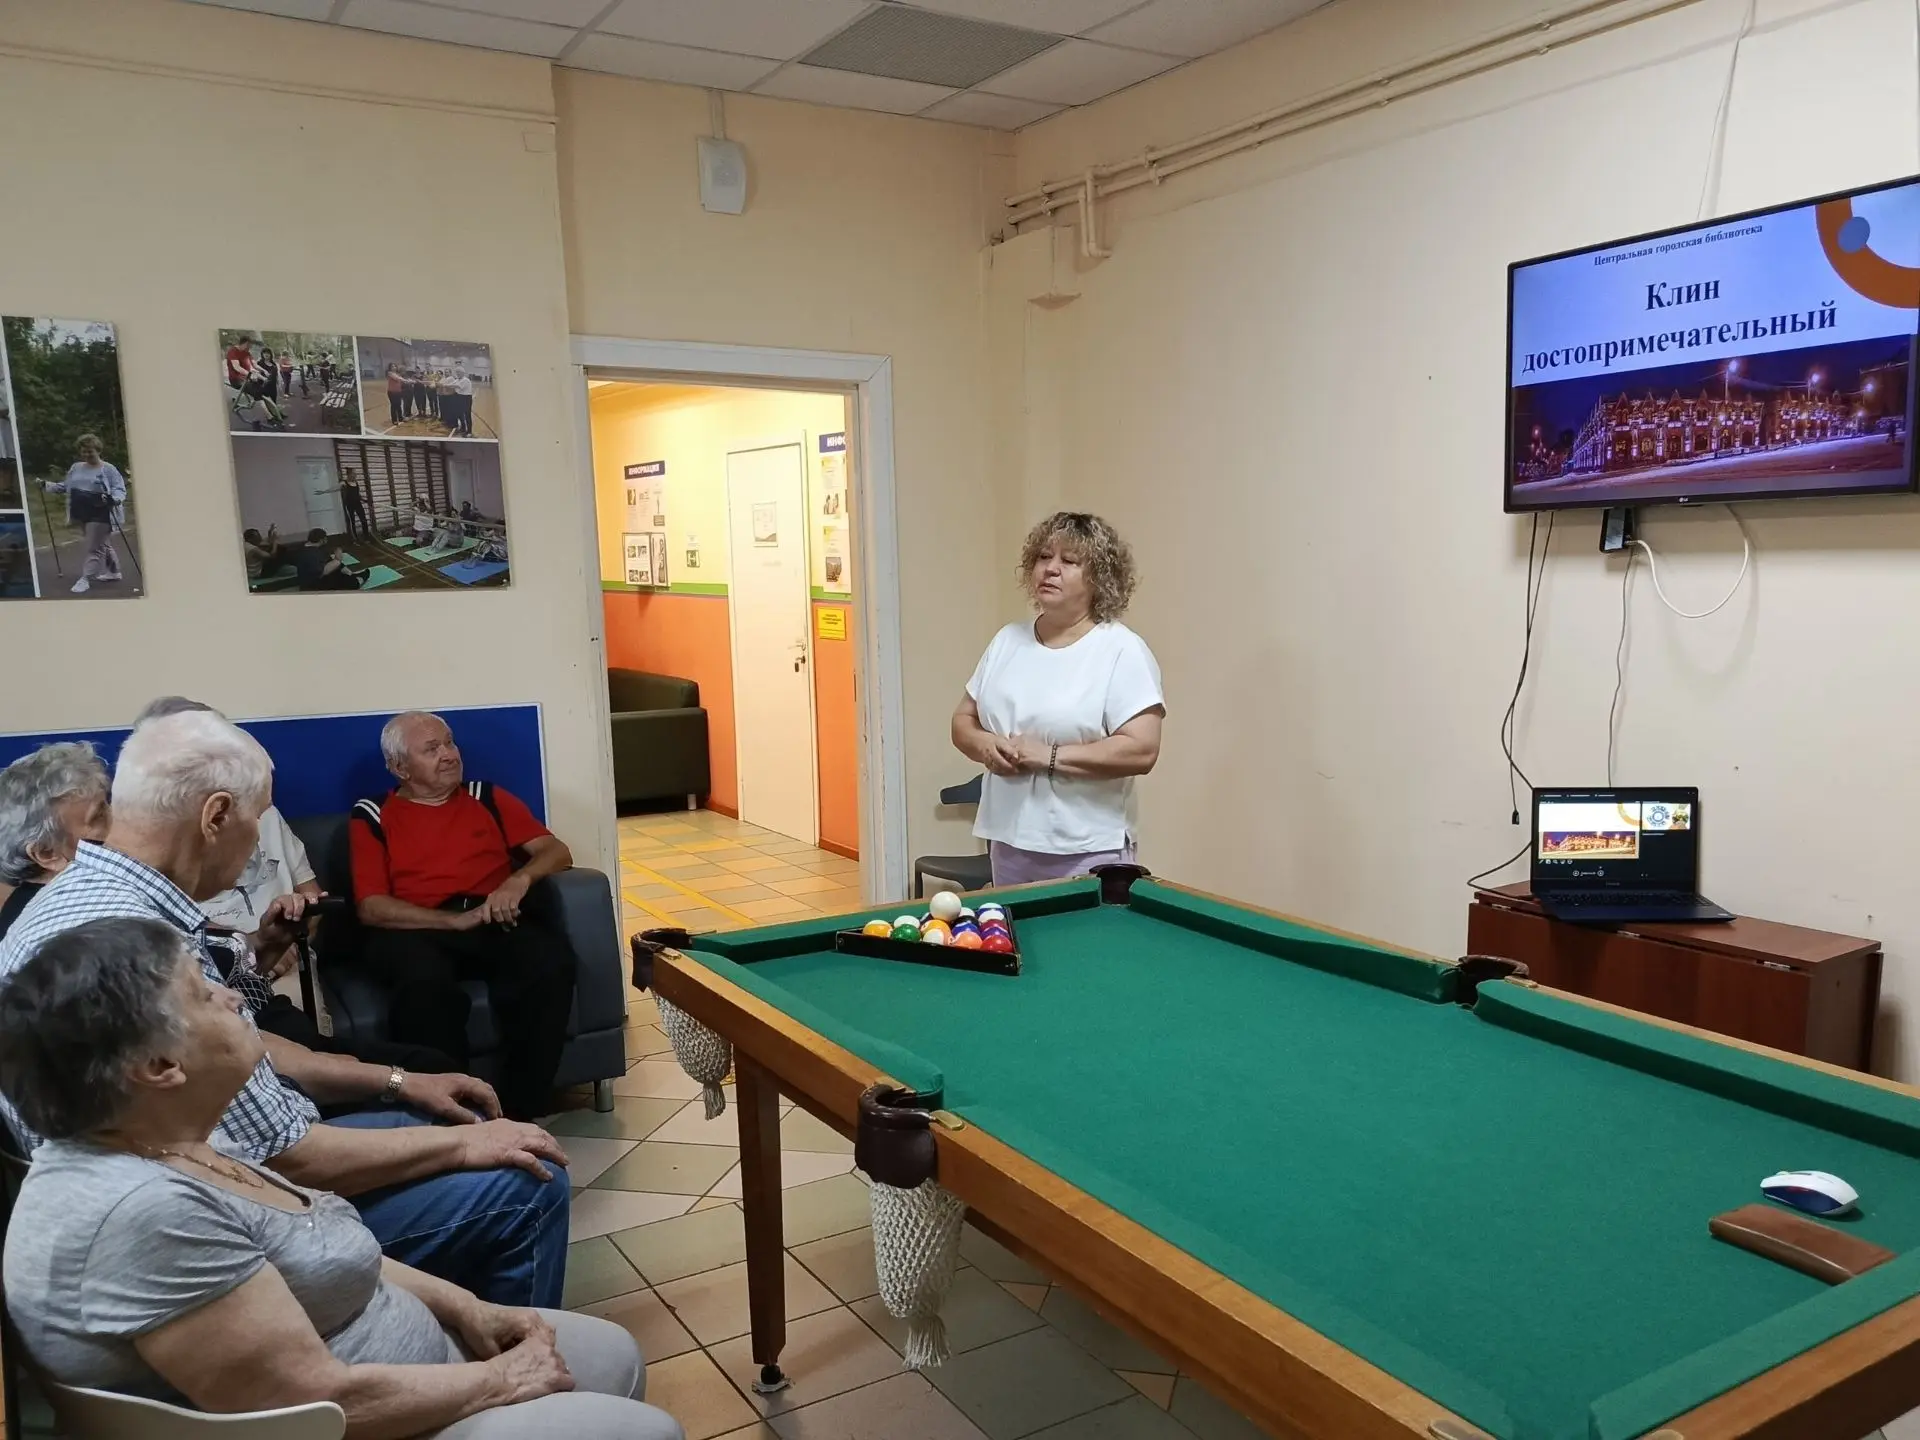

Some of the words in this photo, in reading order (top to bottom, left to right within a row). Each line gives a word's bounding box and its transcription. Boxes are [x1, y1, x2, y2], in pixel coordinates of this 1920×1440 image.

[1594, 247, 1653, 267] Центральная
[1655, 235, 1703, 254] городская
[1705, 224, 1763, 243] библиотека
[1645, 279, 1721, 311] Клин
[1522, 299, 1838, 374] достопримечательный
